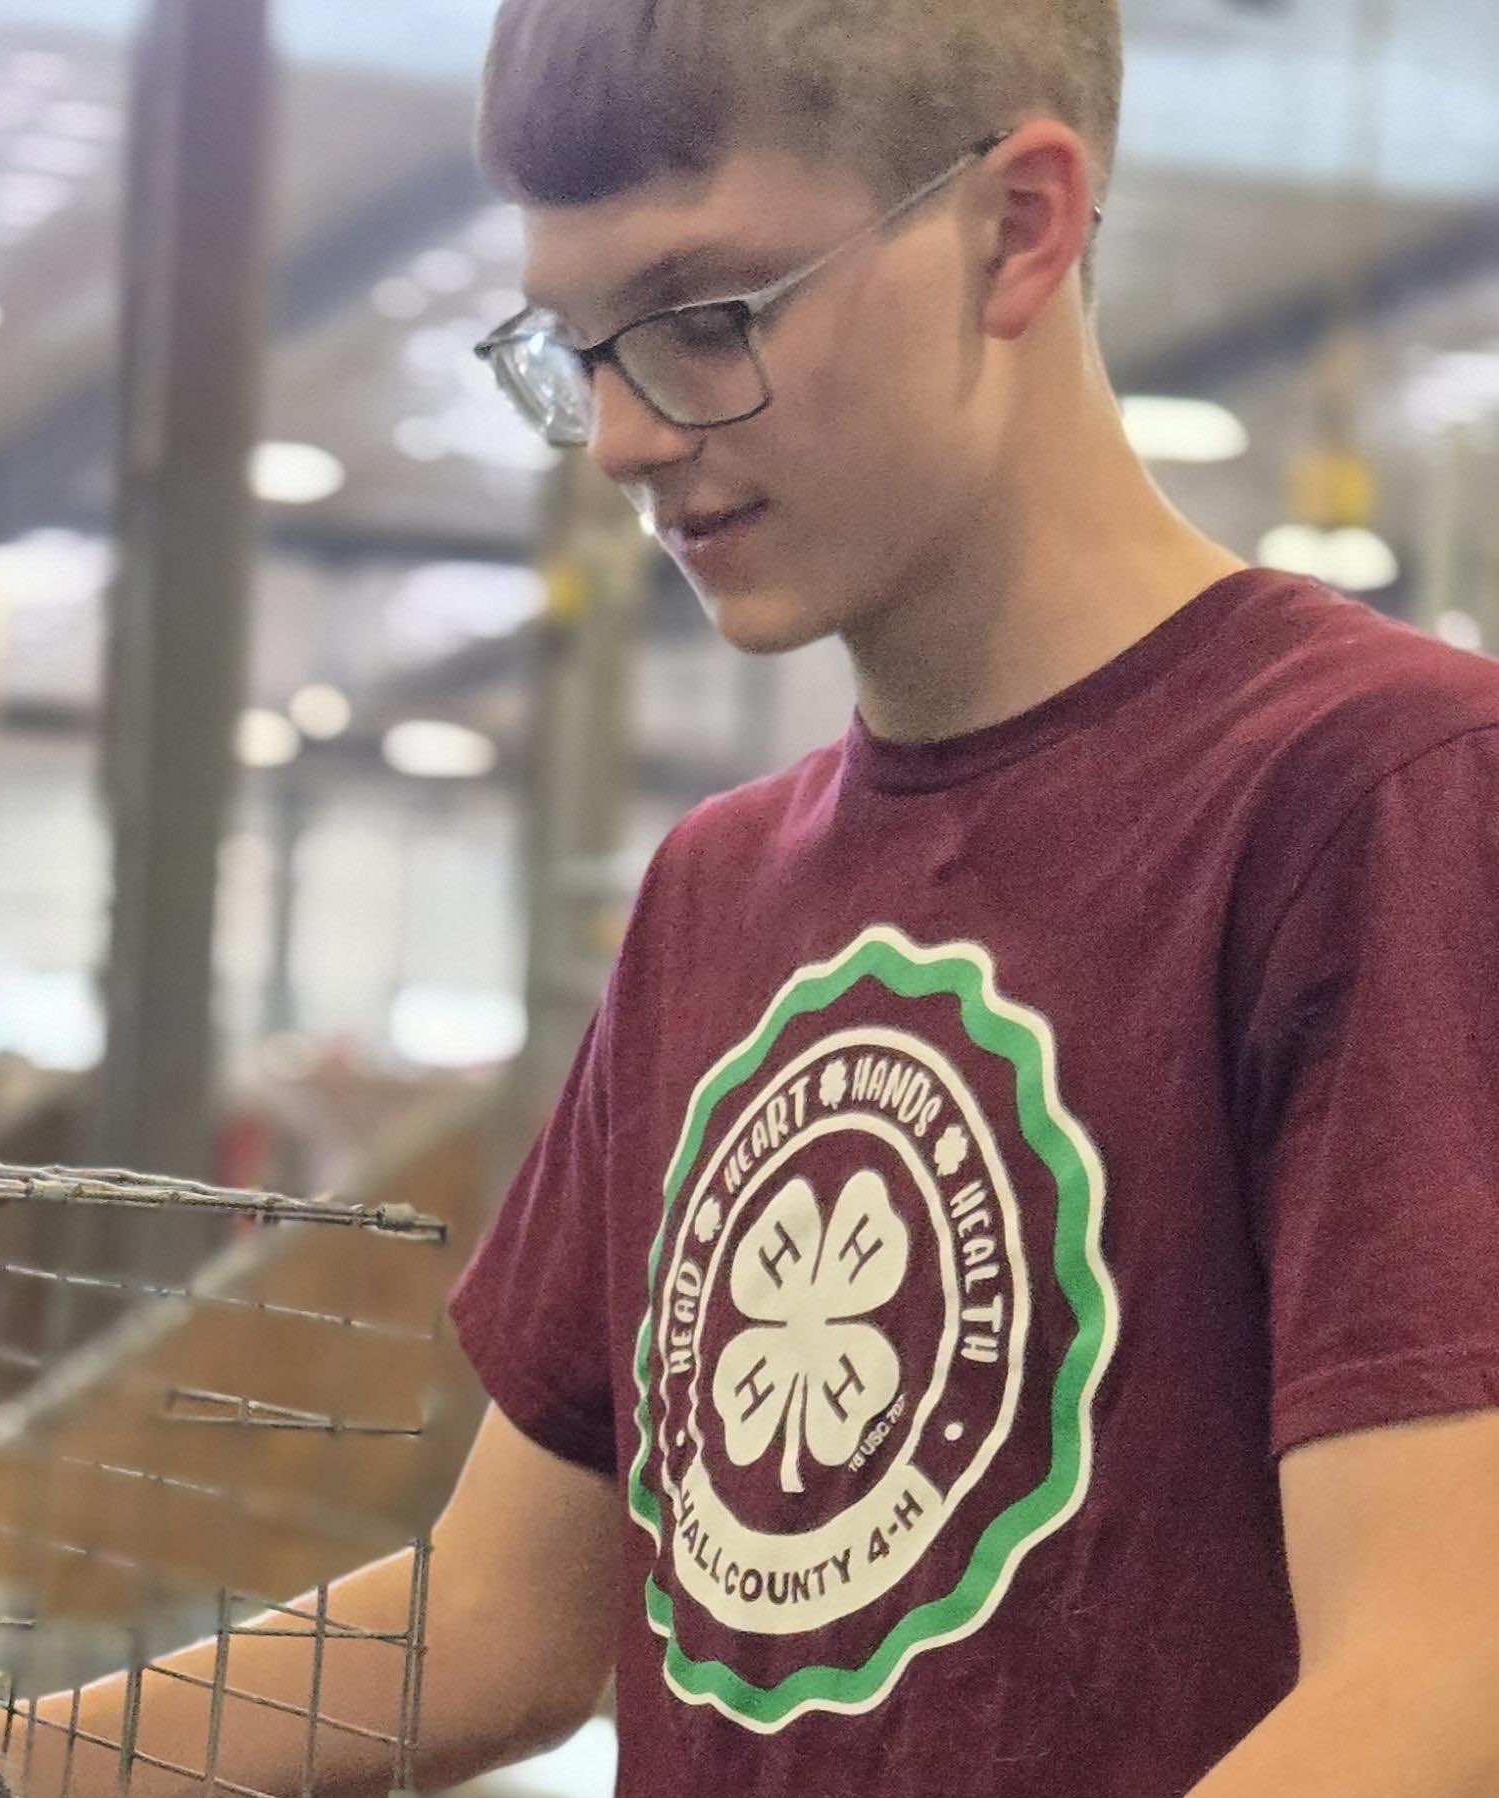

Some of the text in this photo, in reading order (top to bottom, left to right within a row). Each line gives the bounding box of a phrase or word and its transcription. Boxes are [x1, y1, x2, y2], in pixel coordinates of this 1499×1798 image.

[669, 1054, 1004, 1375] HEAD HEART HANDS HEALTH
[757, 1213, 885, 1290] H H
[734, 1352, 866, 1424] H H
[867, 1489, 925, 1565] 4-H
